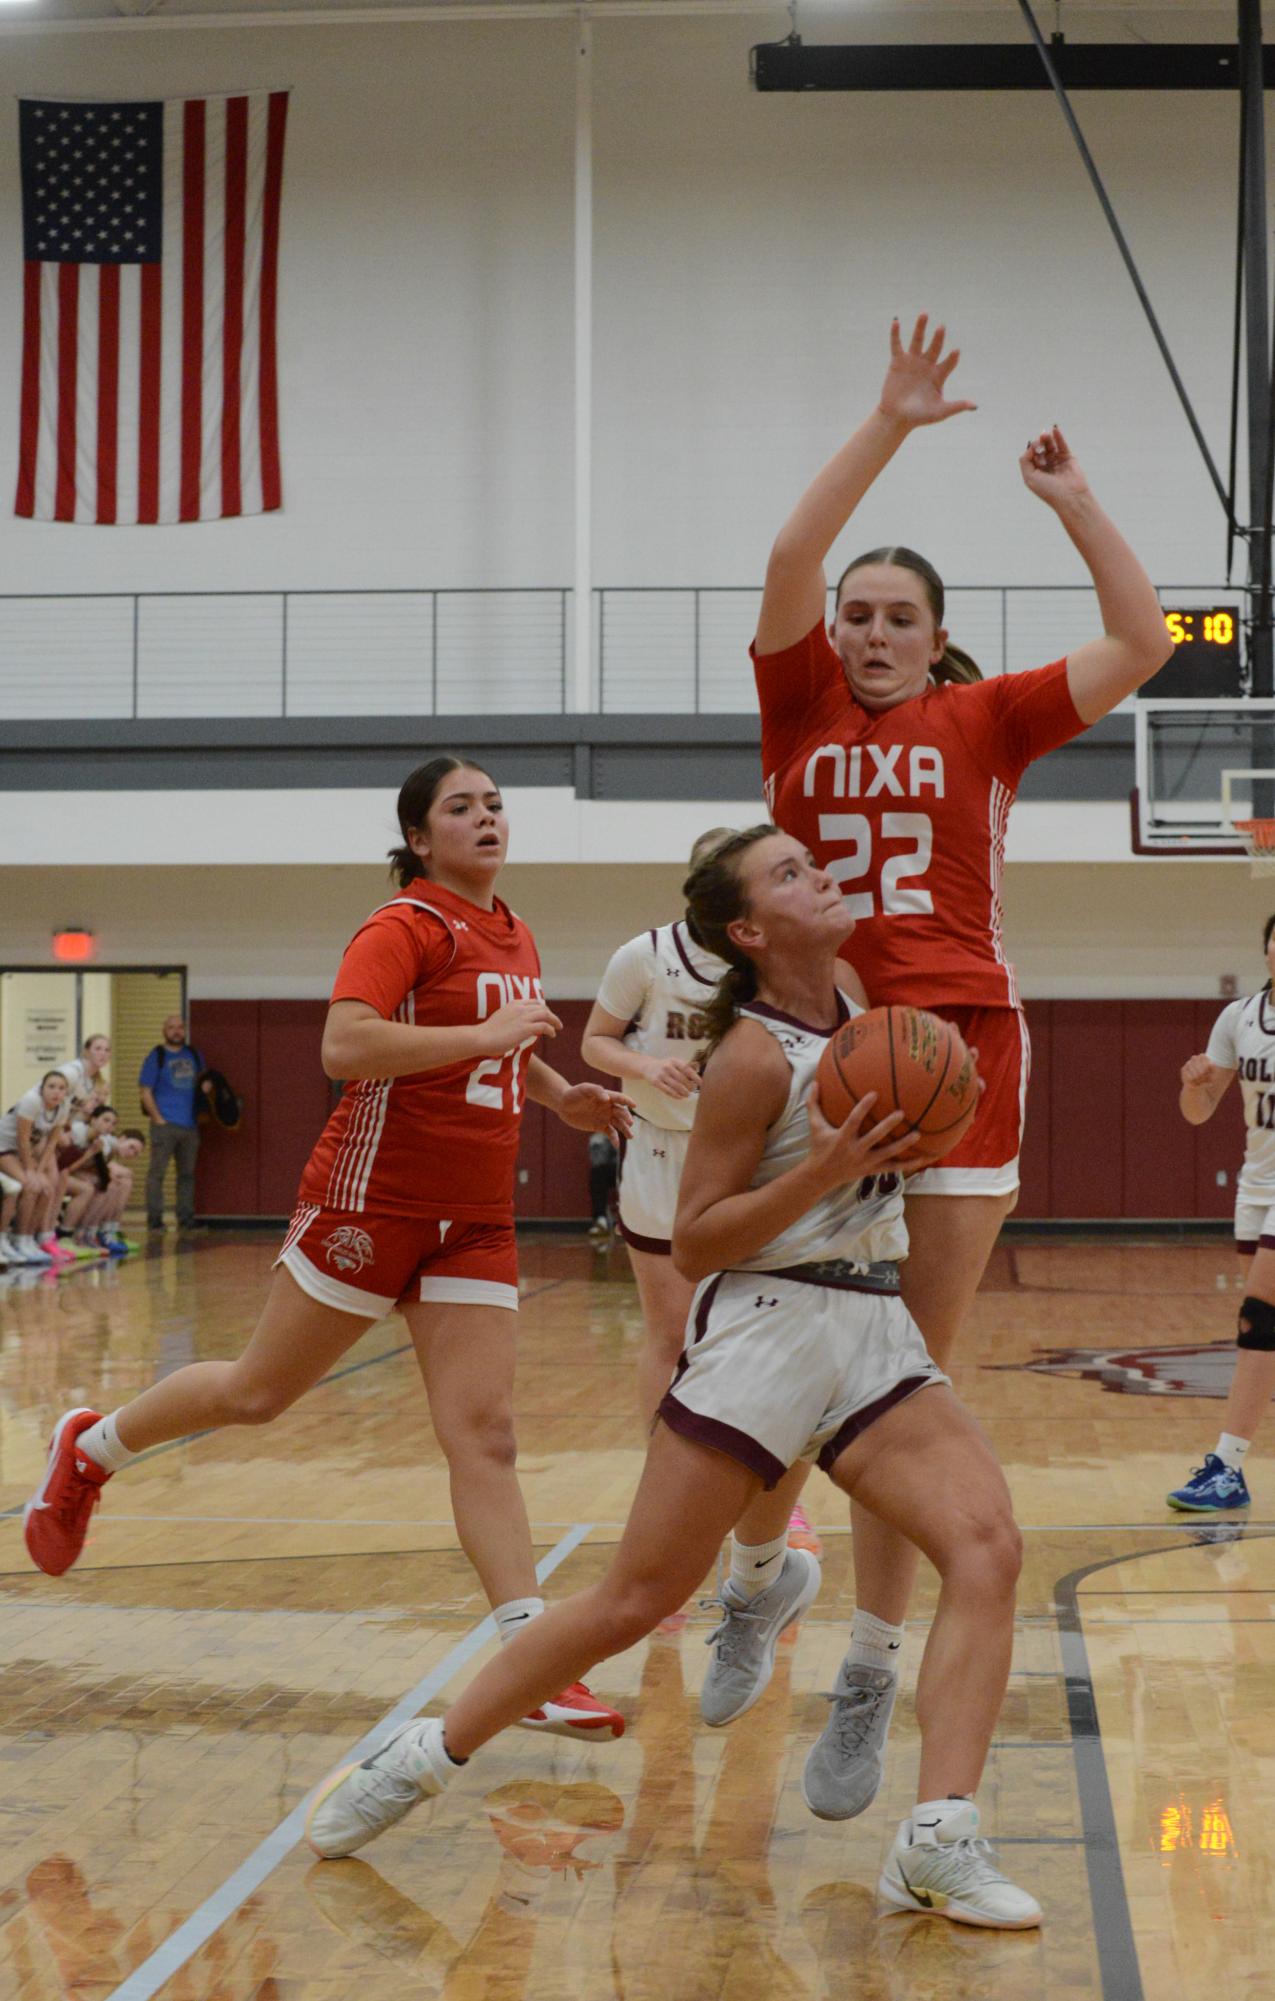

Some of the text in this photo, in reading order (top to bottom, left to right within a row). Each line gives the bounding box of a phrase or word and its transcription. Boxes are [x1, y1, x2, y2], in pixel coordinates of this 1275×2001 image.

[803, 743, 945, 798] NIXA
[818, 812, 934, 920] 22
[1238, 1056, 1275, 1083] ROL
